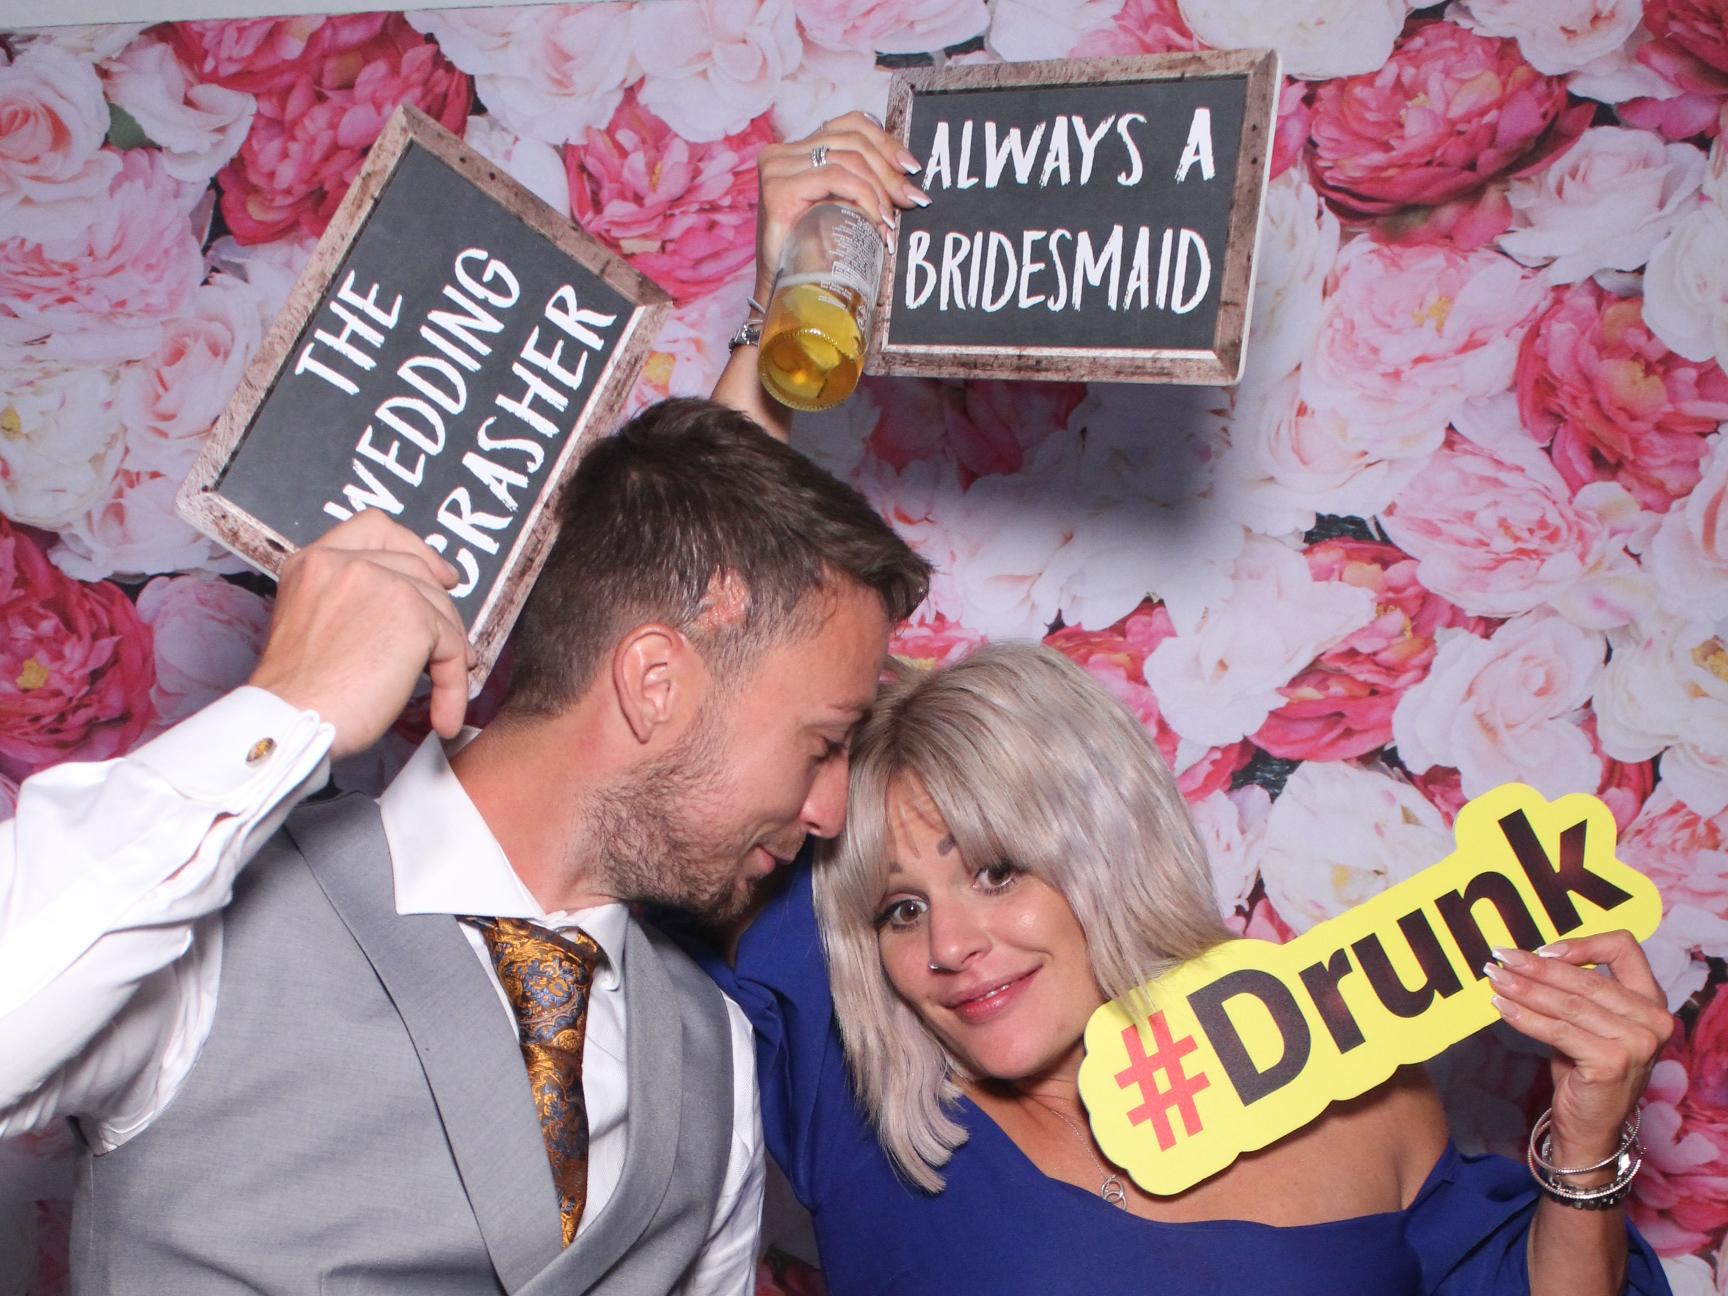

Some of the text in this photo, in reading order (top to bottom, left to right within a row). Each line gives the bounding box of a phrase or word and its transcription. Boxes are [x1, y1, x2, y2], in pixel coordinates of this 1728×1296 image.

[921, 107, 1215, 191] ALWAYS A
[295, 270, 402, 395] THE
[905, 224, 1211, 315] BRIDESMAID
[323, 248, 520, 523] WEDDING
[425, 284, 617, 598] CRASHER
[1114, 808, 1634, 1152] #Drunk
